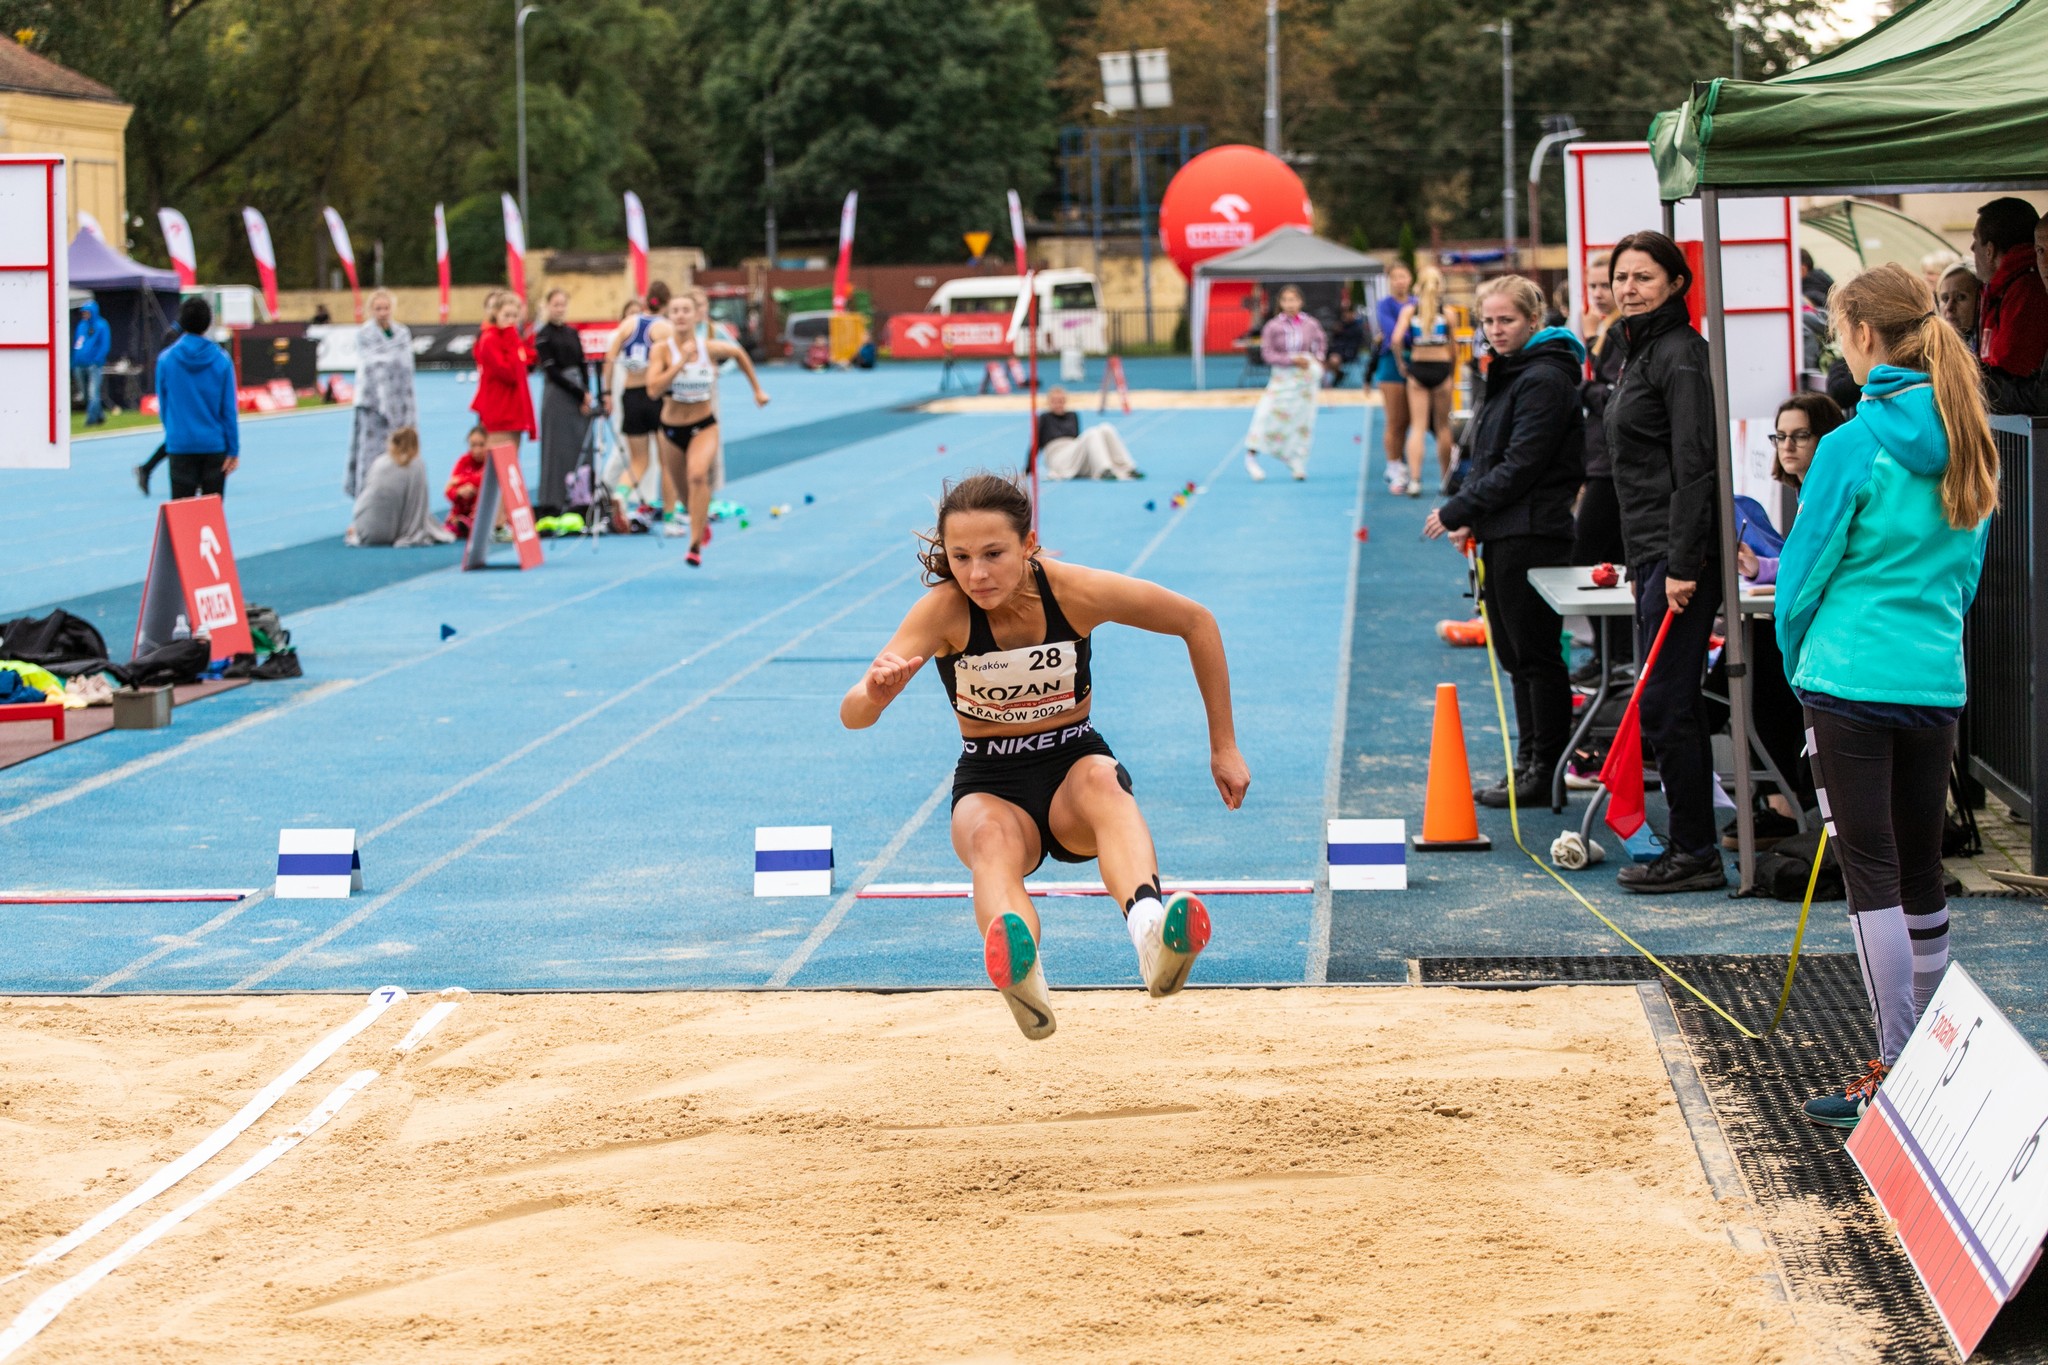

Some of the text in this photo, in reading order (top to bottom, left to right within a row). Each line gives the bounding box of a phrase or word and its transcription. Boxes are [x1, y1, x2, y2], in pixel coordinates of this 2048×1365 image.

[200, 592, 232, 622] ORLEN
[971, 661, 1009, 672] Kraków
[1029, 647, 1062, 671] 28
[969, 680, 1061, 701] KOZAN
[968, 704, 1064, 722] KRAKÓW 2022
[986, 731, 1057, 755] NIKE
[380, 991, 396, 1004] 7
[1927, 1014, 1962, 1053] polanik
[1942, 1016, 1984, 1087] 5
[2011, 1115, 2048, 1183] 6
